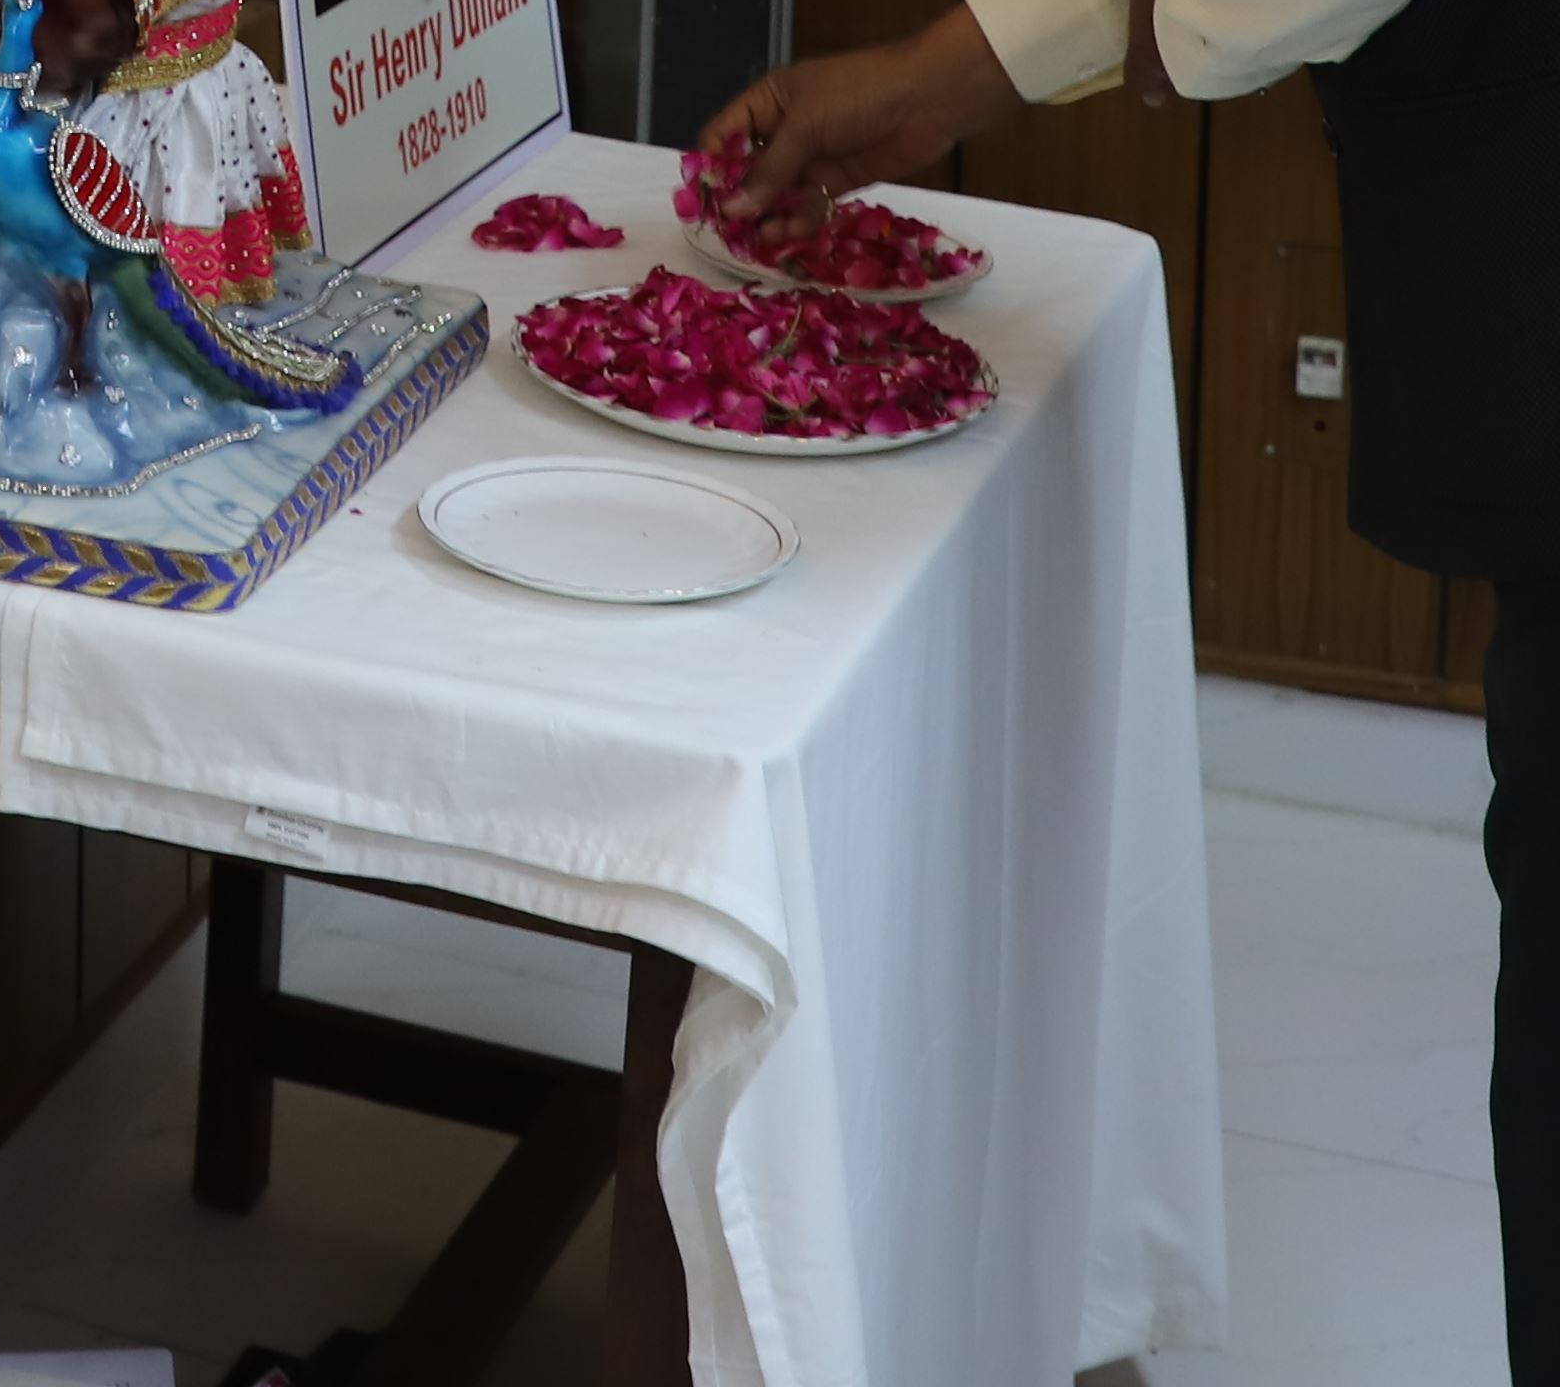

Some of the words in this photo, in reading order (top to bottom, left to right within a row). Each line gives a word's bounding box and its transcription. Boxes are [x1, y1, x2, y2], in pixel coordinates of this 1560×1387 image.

[329, 49, 367, 127] Sir
[371, 12, 442, 100] Henry
[398, 77, 487, 174] 1828-1910
